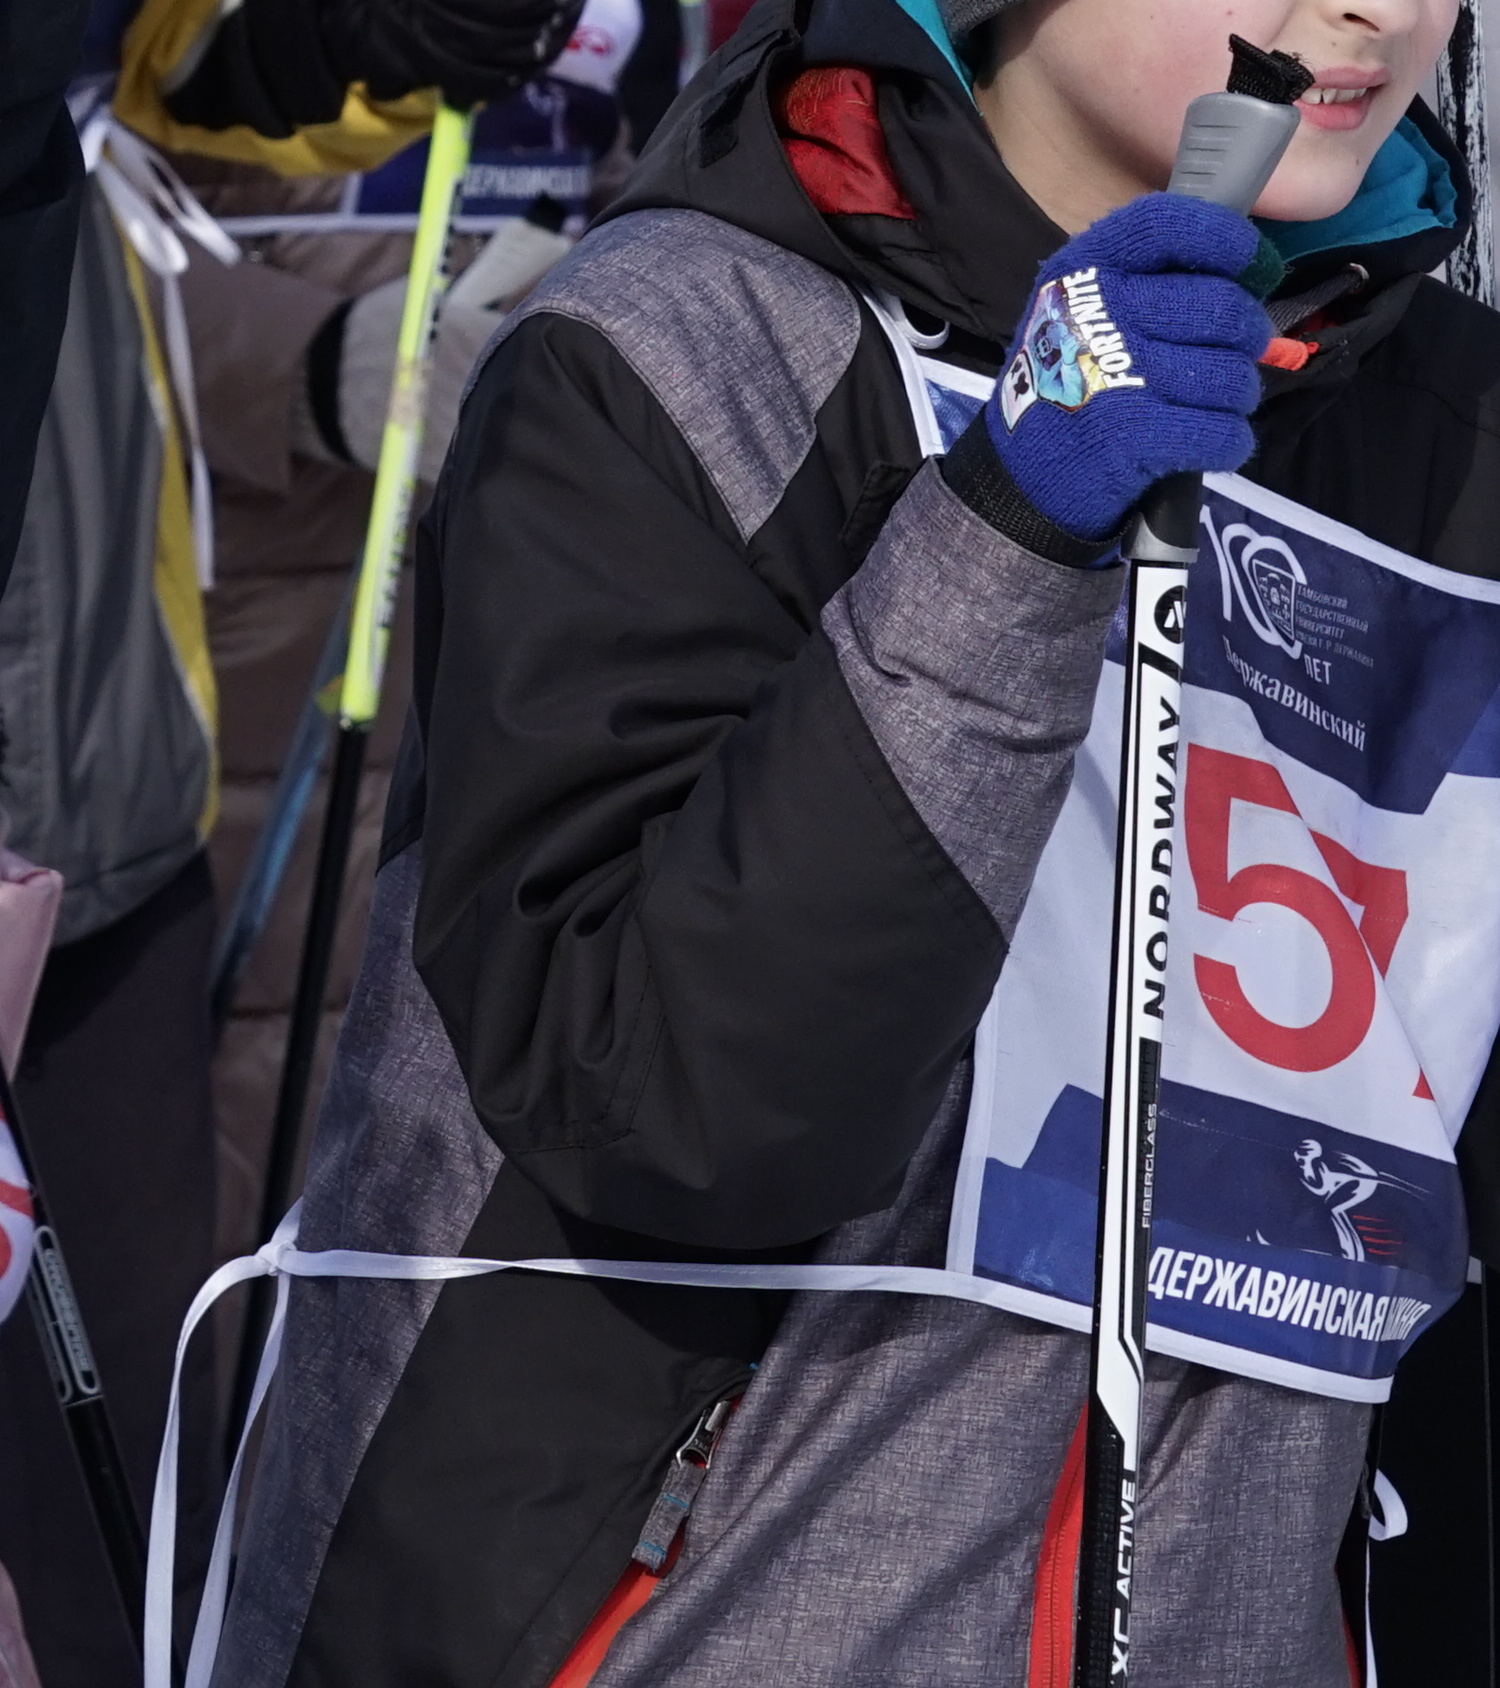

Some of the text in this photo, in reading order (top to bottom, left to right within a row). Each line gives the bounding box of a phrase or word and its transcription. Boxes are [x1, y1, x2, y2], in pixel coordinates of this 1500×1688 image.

[1062, 267, 1145, 389] FORTNITE
[1303, 653, 1333, 686] ЛЕТ
[1143, 695, 1180, 1021] NORDWAY
[1141, 1103, 1158, 1229] FIBERGLASS
[1147, 1245, 1390, 1342] ДЕРЖАВИНСКАЯ
[1116, 1478, 1137, 1601] ACTIVE
